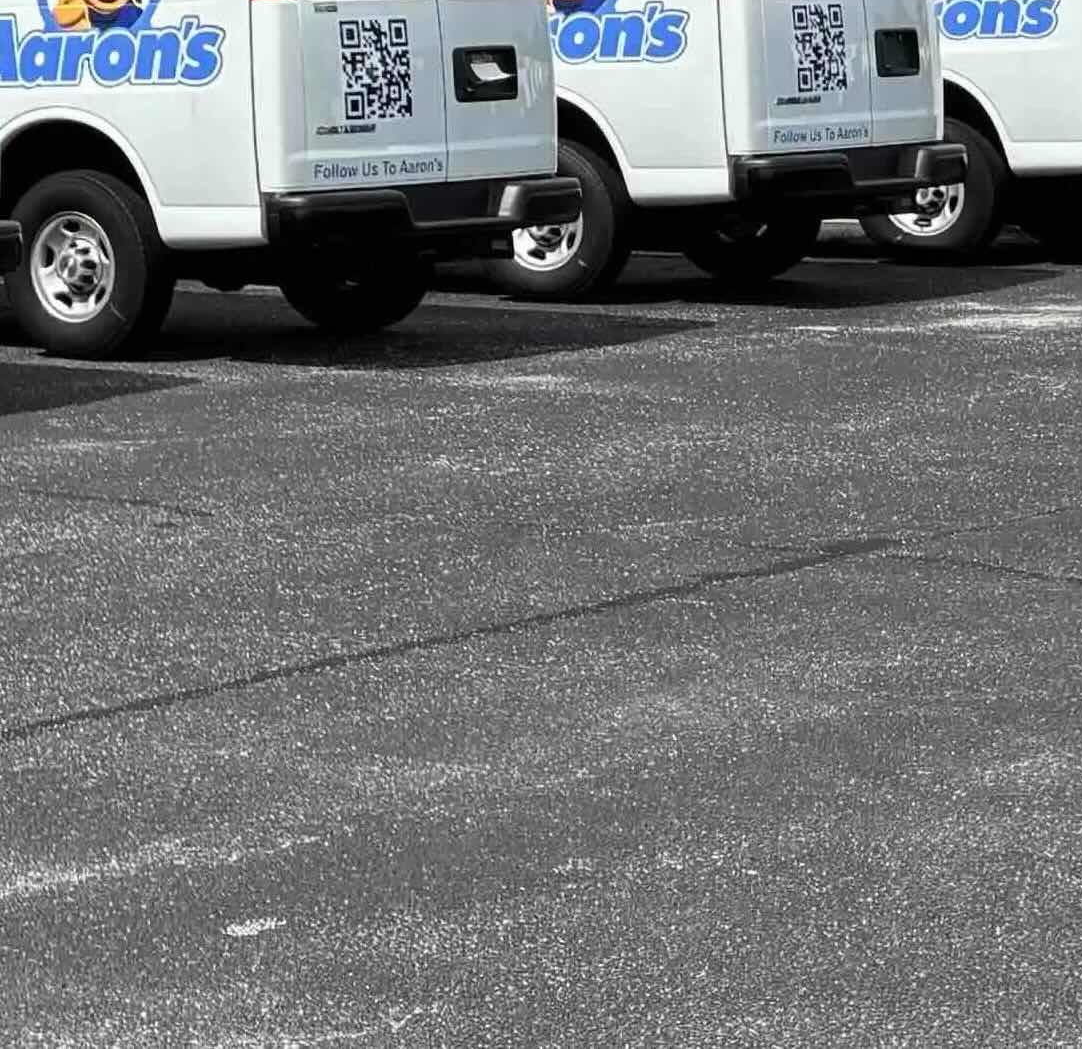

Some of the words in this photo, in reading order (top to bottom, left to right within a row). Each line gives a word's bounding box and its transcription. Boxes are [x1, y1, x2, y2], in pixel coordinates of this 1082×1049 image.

[774, 129, 808, 143] Follow
[810, 129, 822, 142] Us
[825, 127, 836, 141] To
[313, 163, 359, 179] Follow
[362, 161, 379, 177] Us
[383, 160, 397, 175] To
[400, 157, 443, 174] Aaron's
